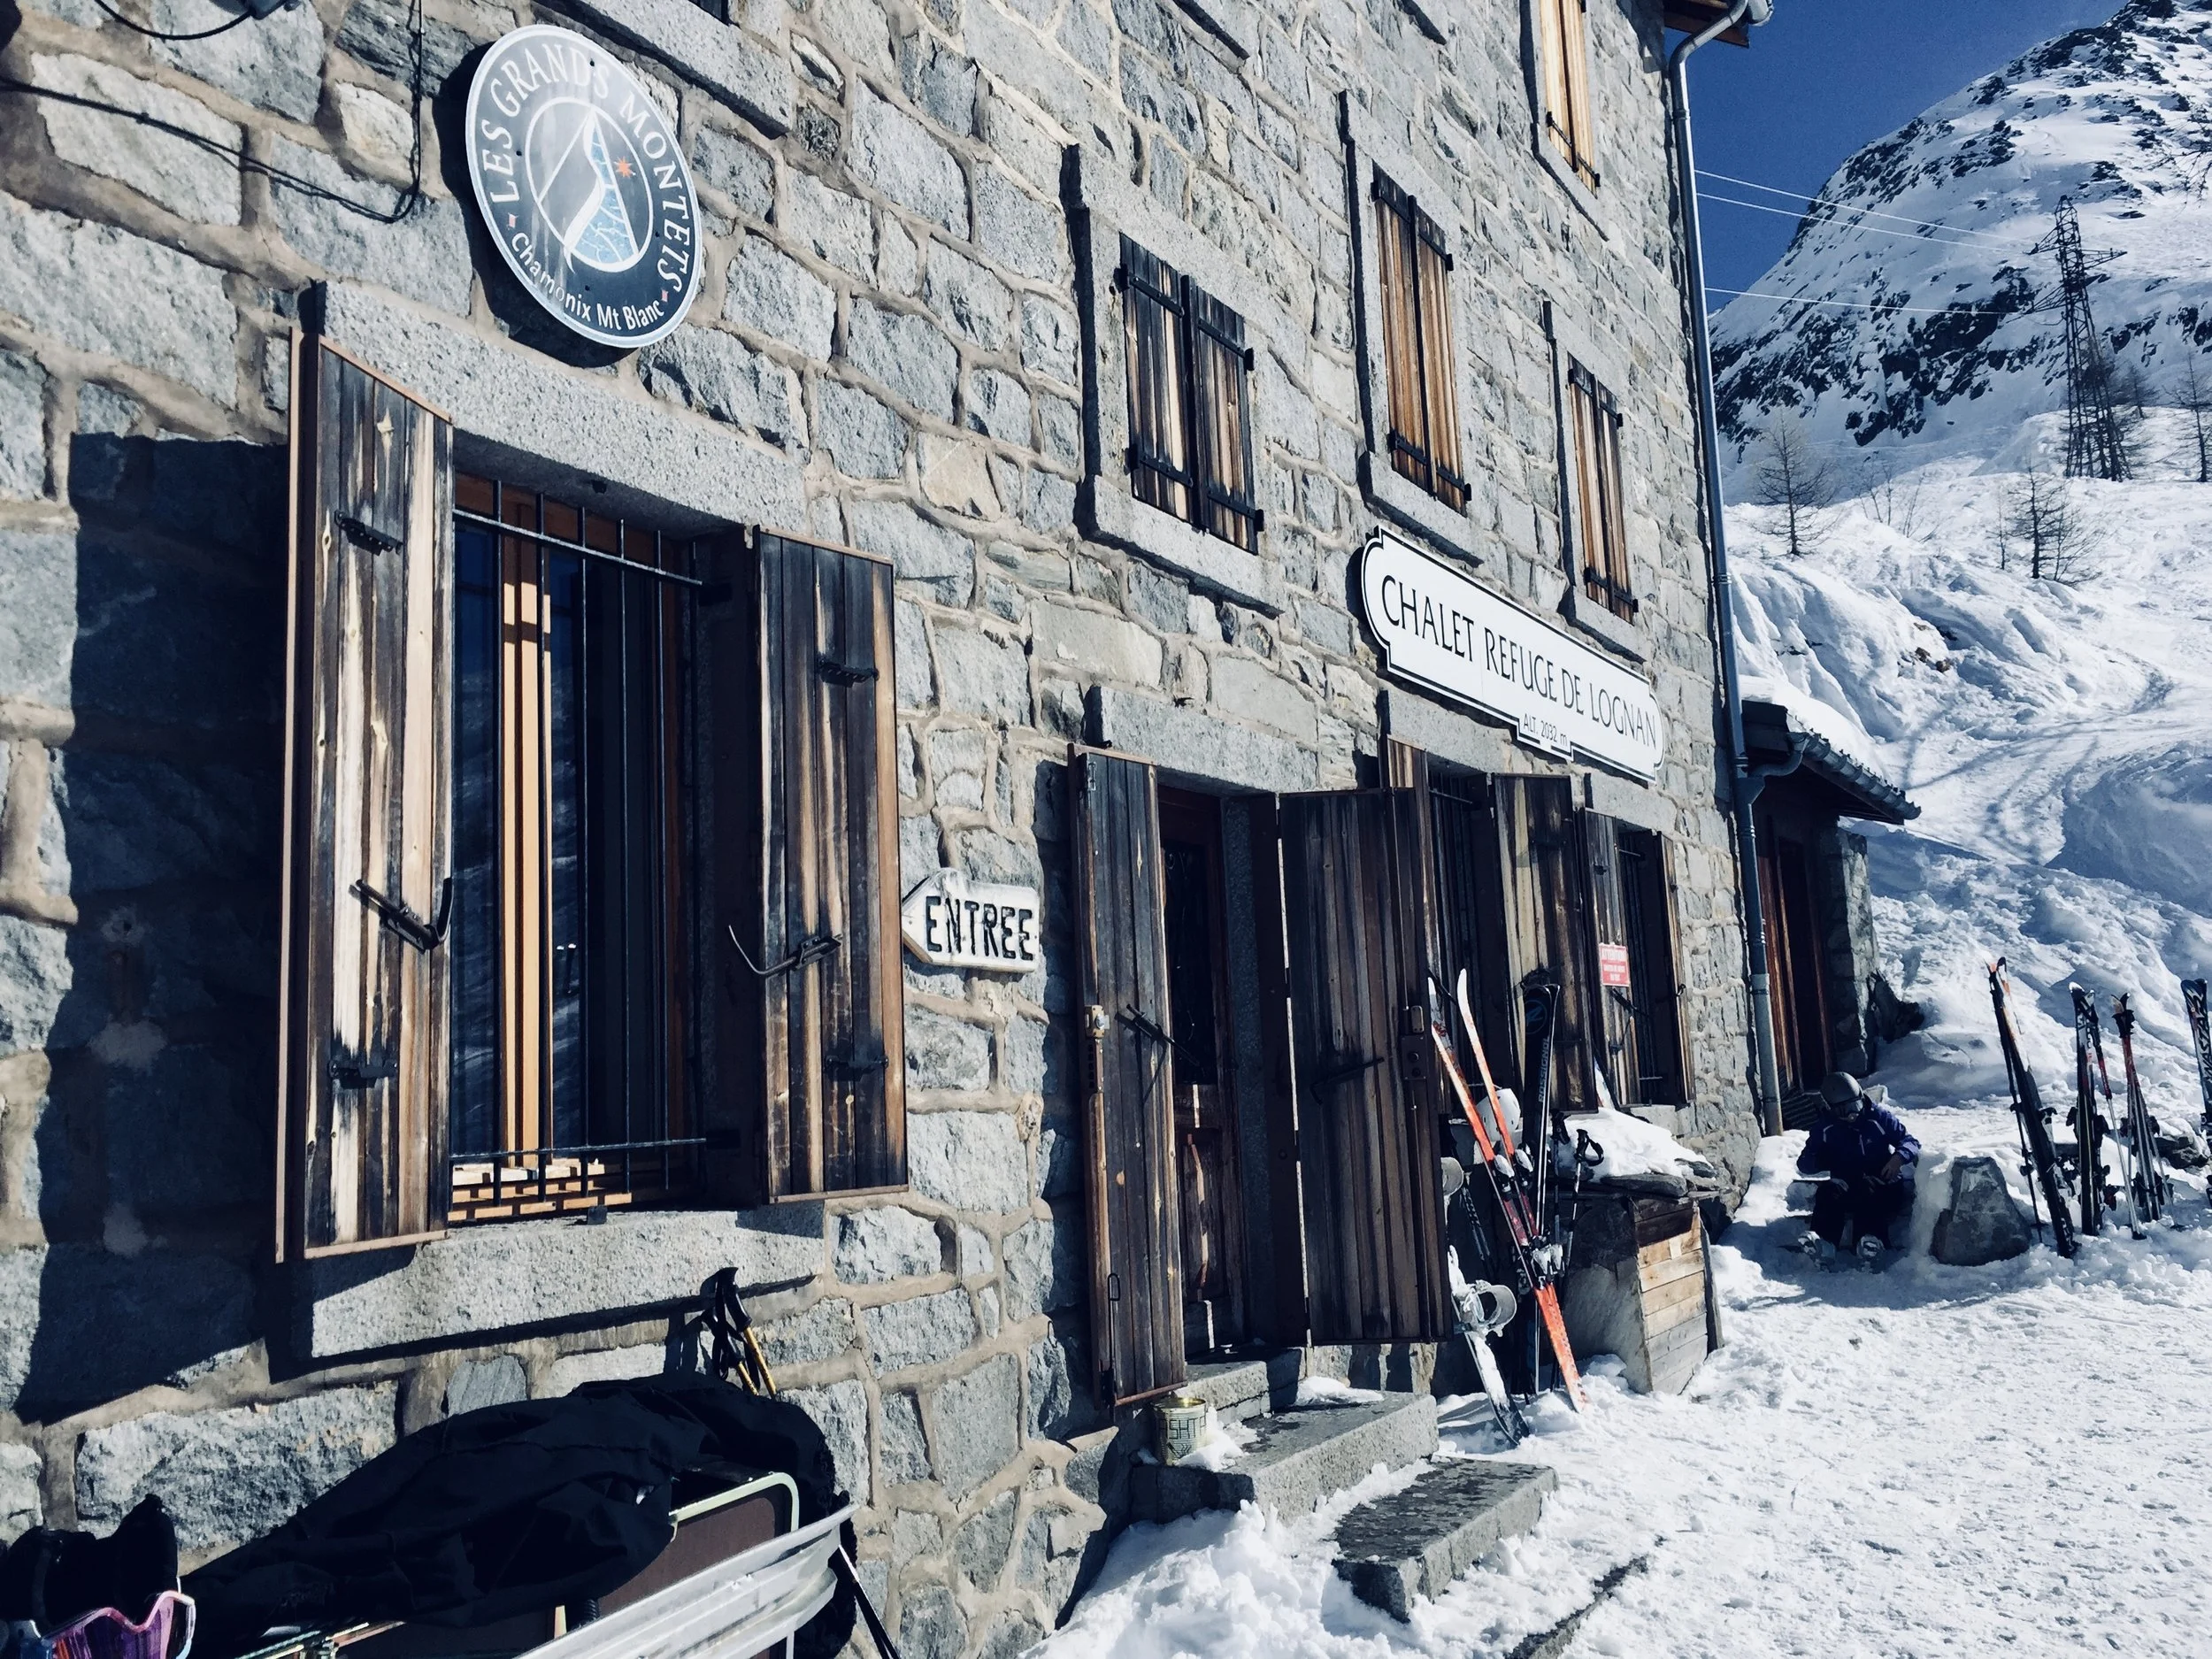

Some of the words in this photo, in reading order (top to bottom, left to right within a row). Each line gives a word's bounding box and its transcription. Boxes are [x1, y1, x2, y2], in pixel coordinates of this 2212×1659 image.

[490, 43, 610, 118] GRANDS
[481, 119, 520, 203] LES
[619, 91, 690, 292] MONTETS
[511, 232, 592, 322] Chamonix
[597, 303, 622, 331] Mt
[622, 299, 664, 331] Blanc
[1381, 574, 1474, 663] CHALET
[1483, 626, 1557, 703] REFUGE
[1561, 668, 1584, 716] DE
[1589, 682, 1657, 751] LOGNAN
[1523, 713, 1540, 734] ALT.
[1540, 720, 1557, 742] 2032
[1560, 733, 1568, 746] m
[926, 895, 1033, 961] ENTREE
[1538, 1035, 1550, 1102] ROSSIGNOL
